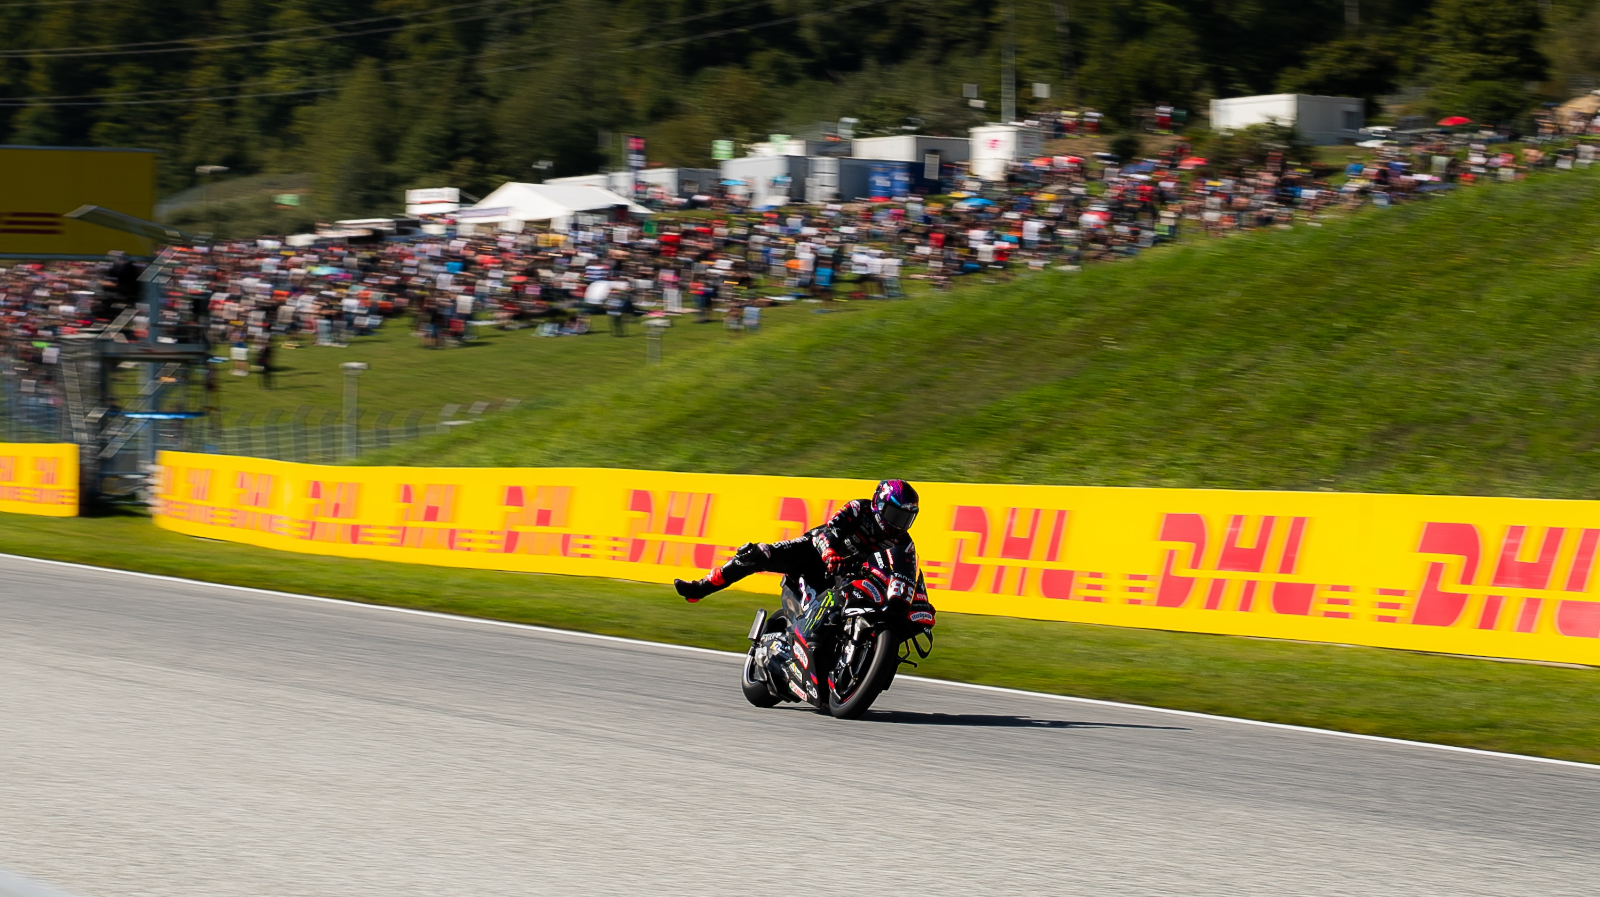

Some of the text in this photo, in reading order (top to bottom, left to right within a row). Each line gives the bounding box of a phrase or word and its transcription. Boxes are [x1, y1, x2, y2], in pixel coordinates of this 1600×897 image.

[949, 505, 1074, 601] DHL
[1154, 513, 1315, 616] DHL
[1409, 522, 1600, 639] DHL
